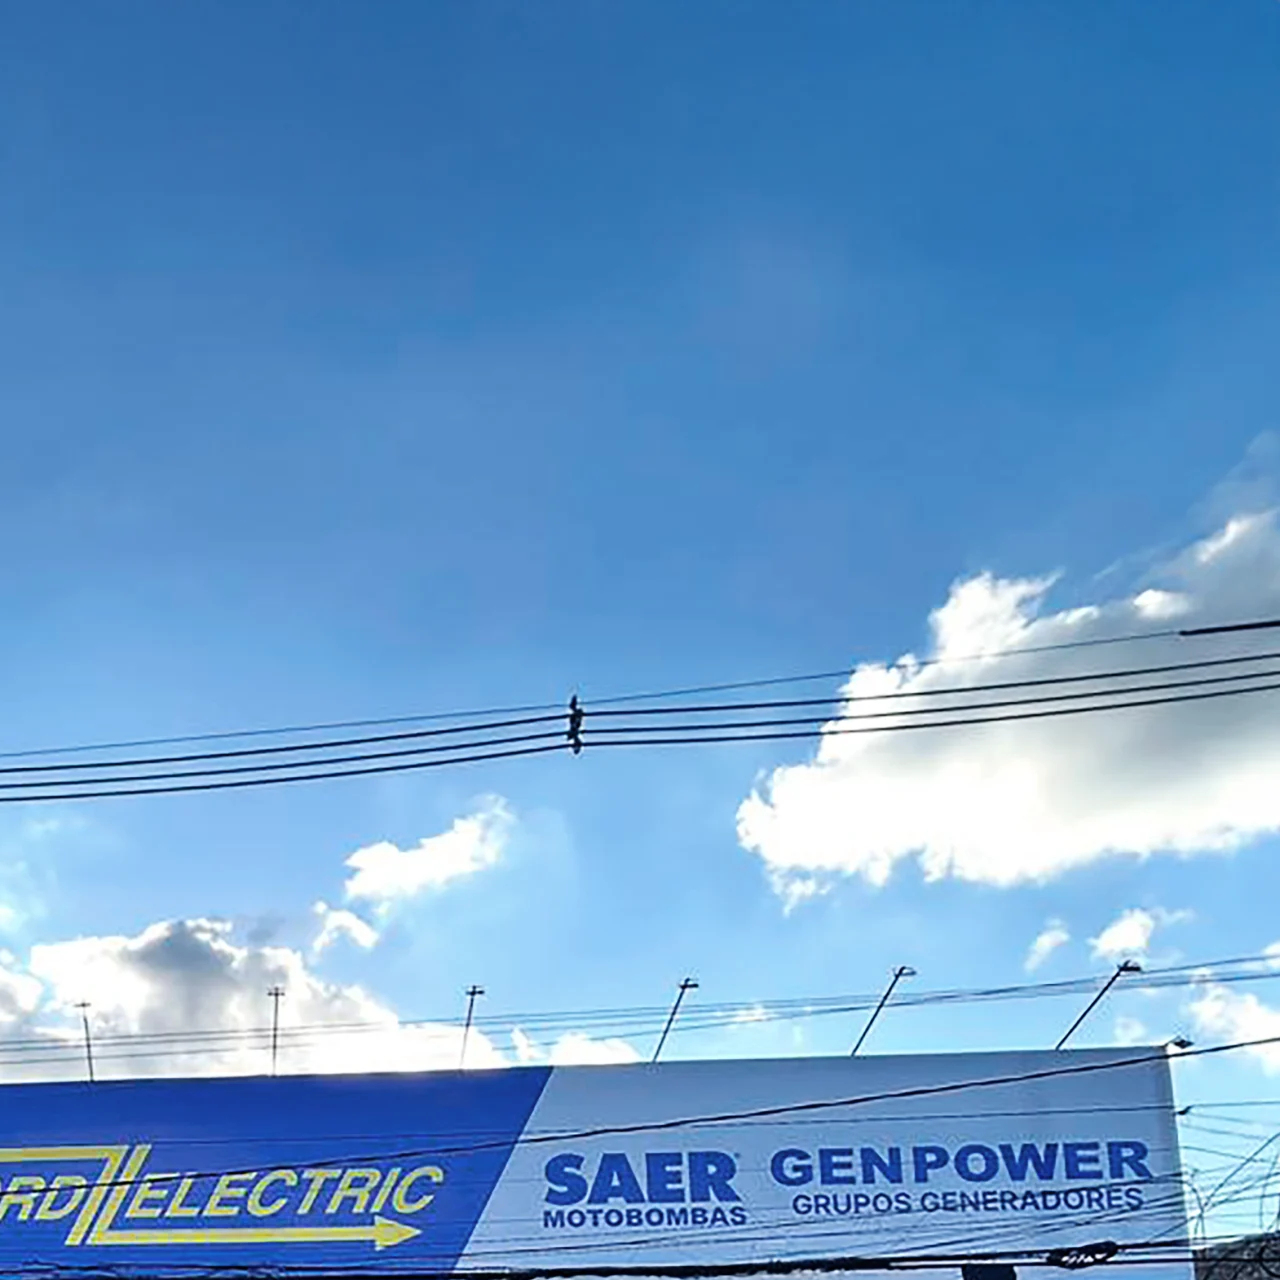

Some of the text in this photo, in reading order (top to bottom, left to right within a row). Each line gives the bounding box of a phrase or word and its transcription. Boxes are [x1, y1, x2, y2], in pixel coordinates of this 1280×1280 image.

[124, 1165, 445, 1218] ELECTRIC
[544, 1151, 742, 1206] SAER
[543, 1207, 748, 1228] MOTOBOMBAS
[792, 1187, 1145, 1215] GRUPOS GENERADORES
